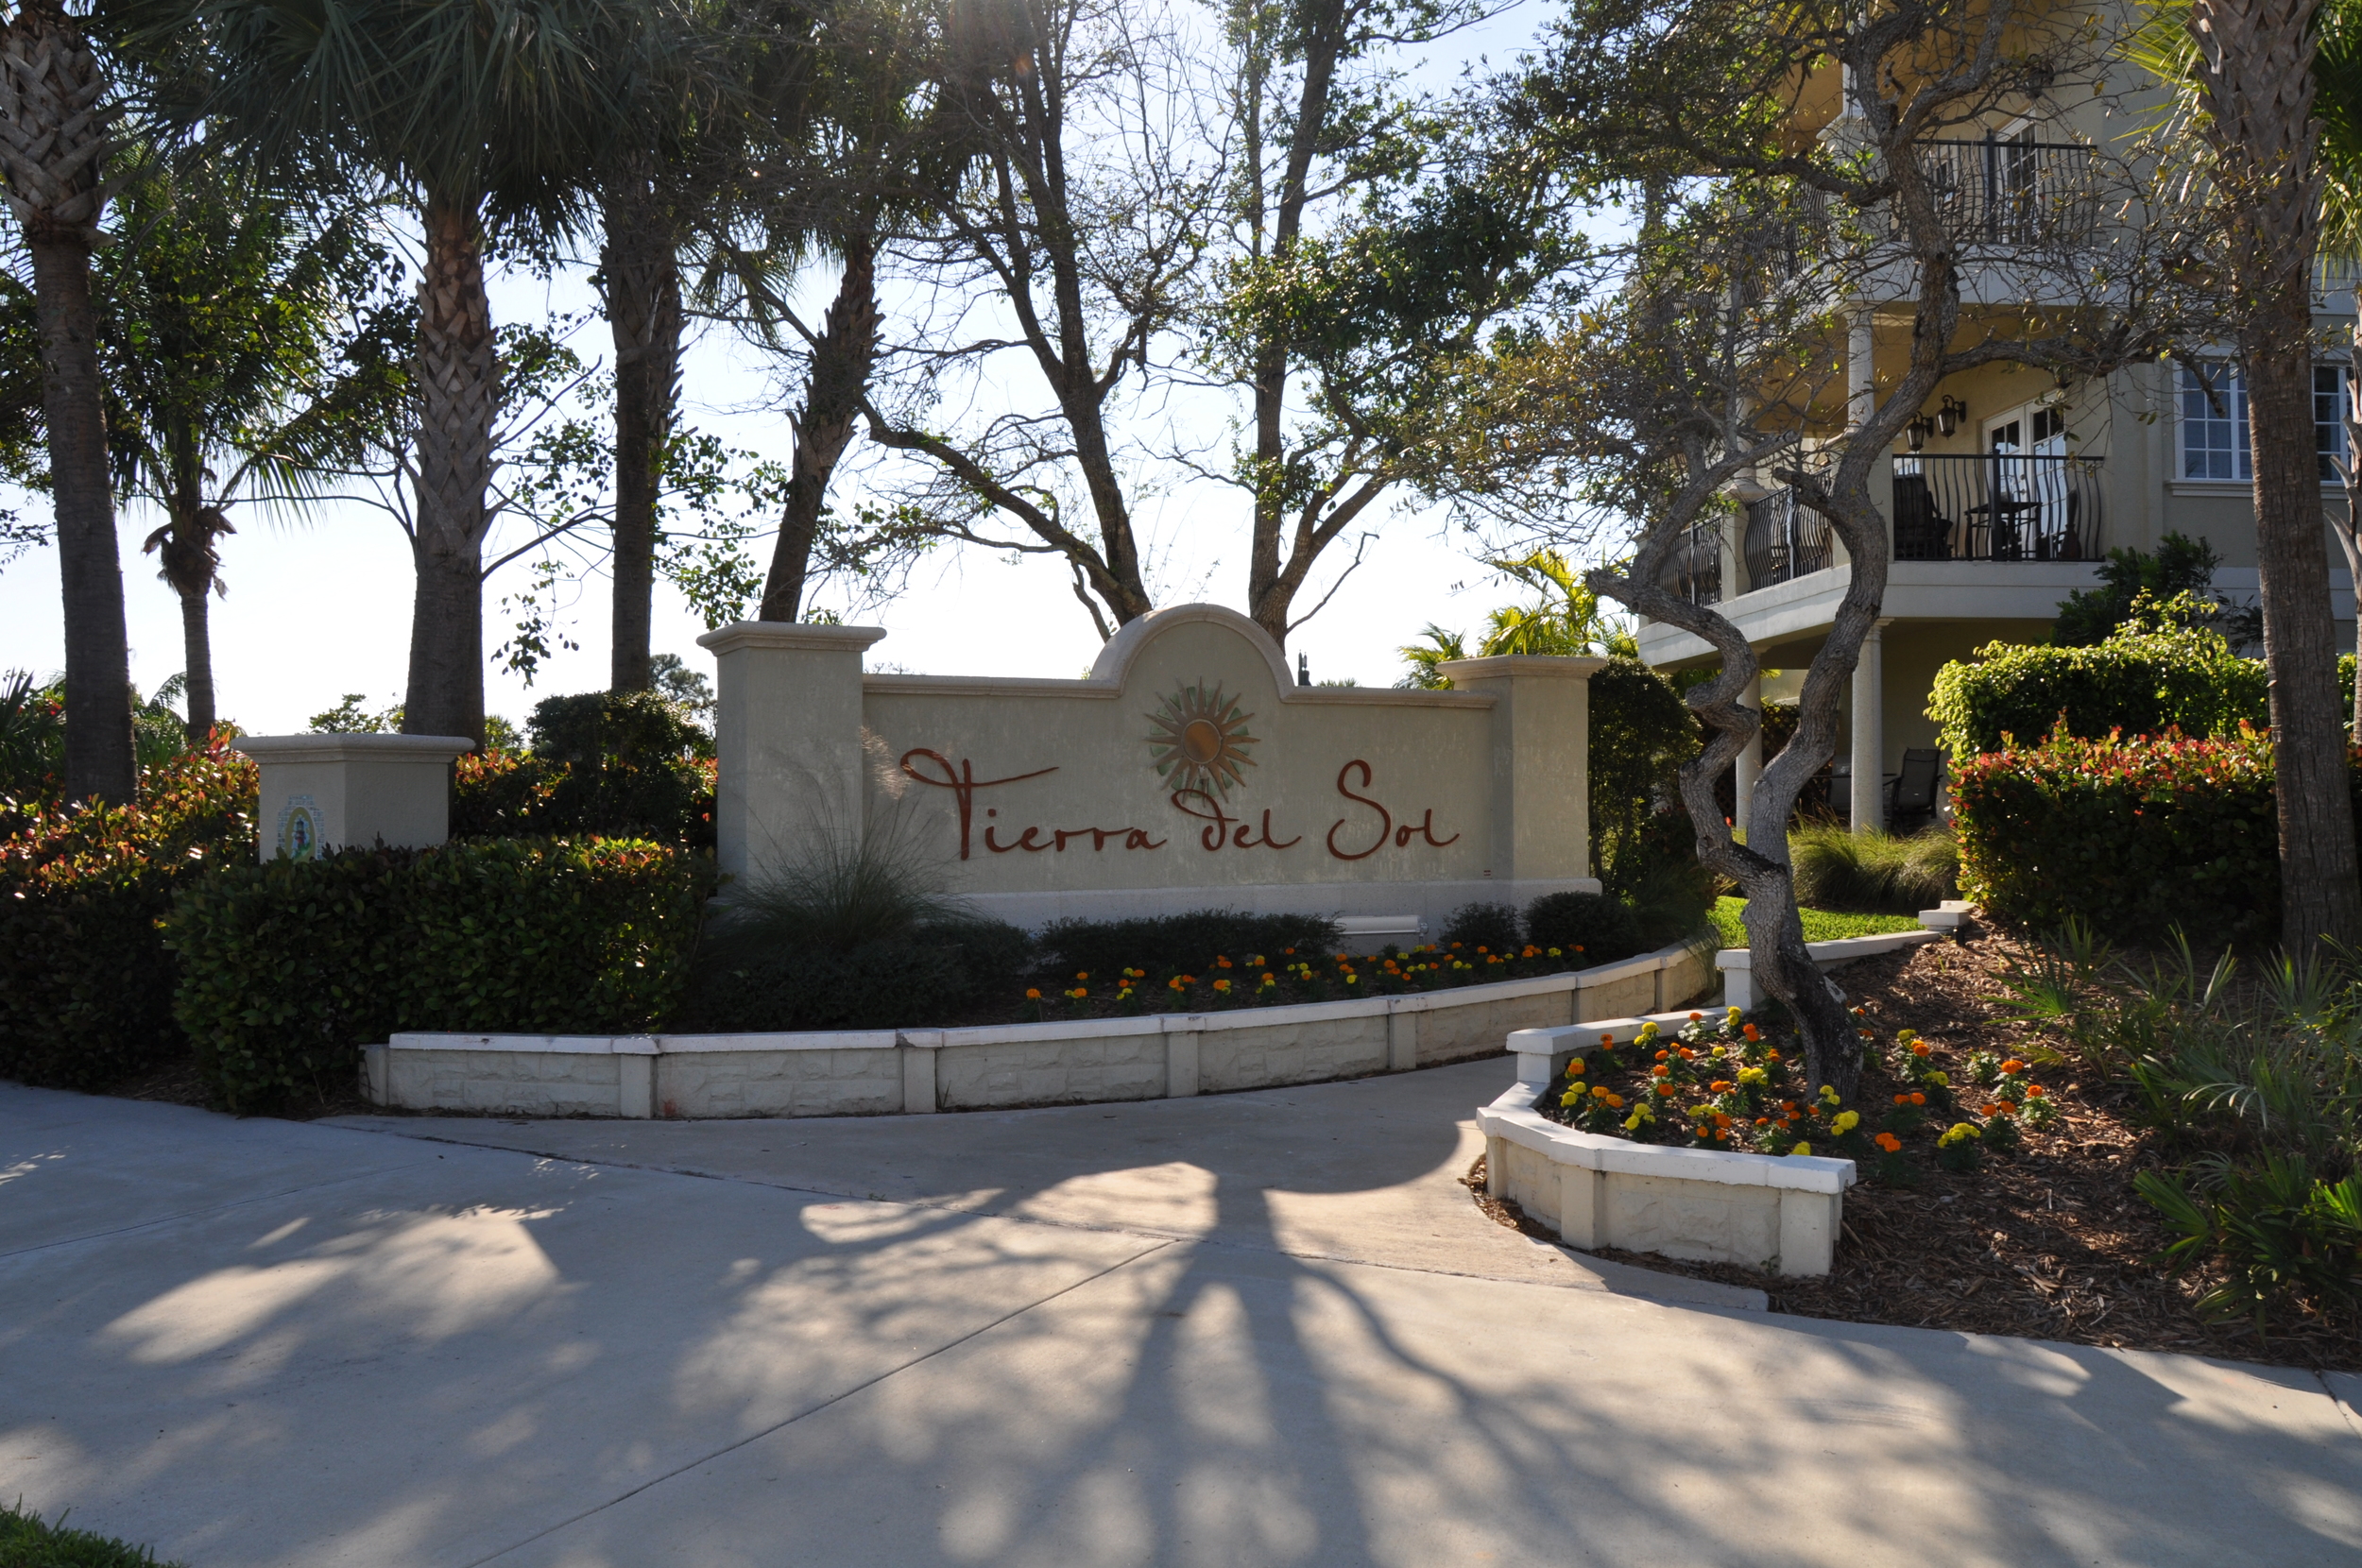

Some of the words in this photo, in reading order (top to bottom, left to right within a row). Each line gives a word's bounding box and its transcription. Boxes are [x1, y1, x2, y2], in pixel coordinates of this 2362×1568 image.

[900, 748, 1167, 861] Tierra
[1171, 789, 1302, 850] del
[1326, 759, 1460, 861] Sol
